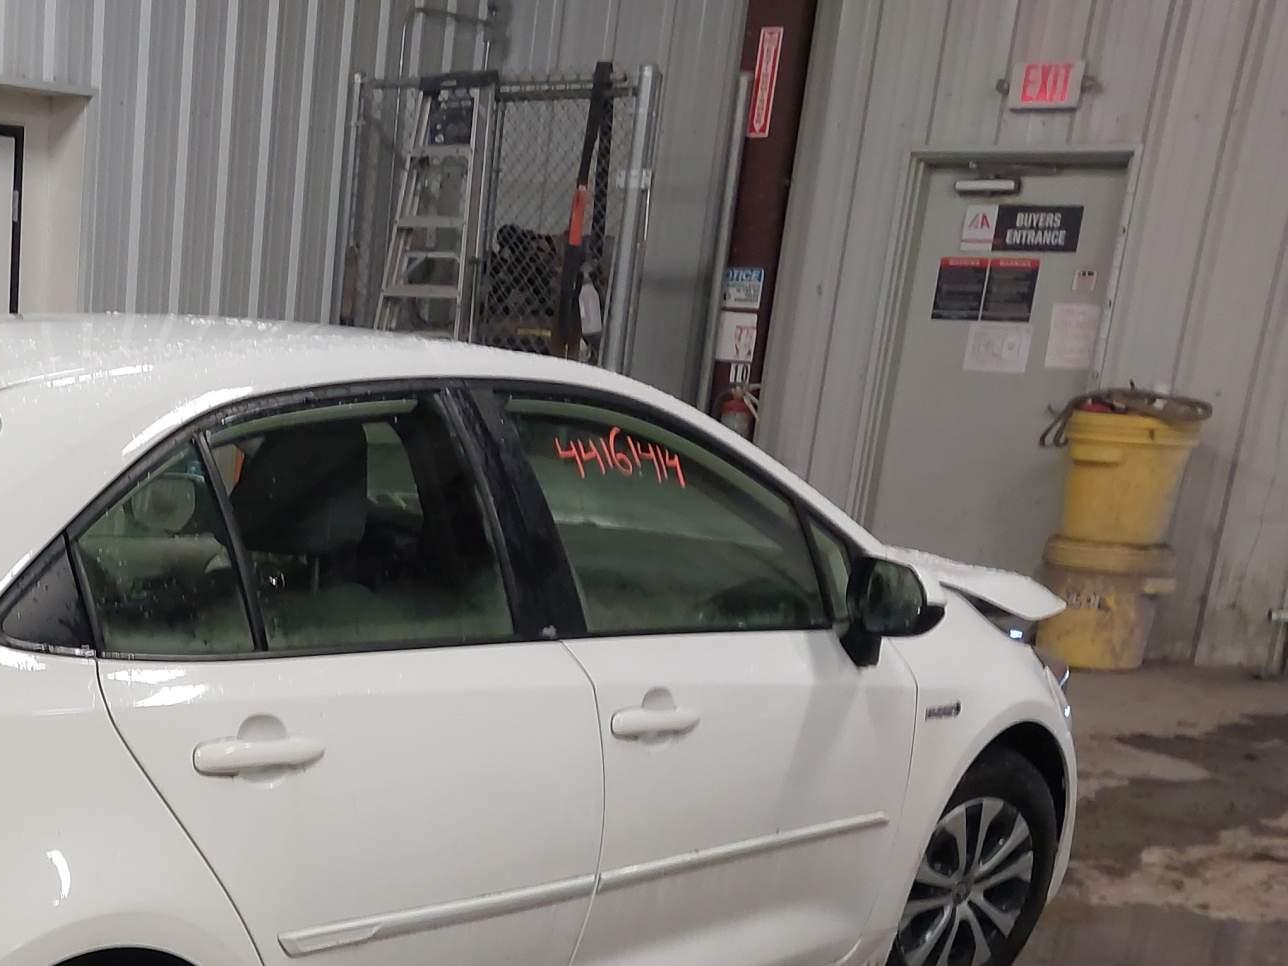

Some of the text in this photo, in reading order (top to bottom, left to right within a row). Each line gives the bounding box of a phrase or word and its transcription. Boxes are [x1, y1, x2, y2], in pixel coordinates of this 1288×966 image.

[1021, 64, 1073, 102] EXIT
[1016, 212, 1062, 229] BUYERS
[1005, 228, 1066, 247] ENTRANCE
[555, 426, 686, 489] 44161414
